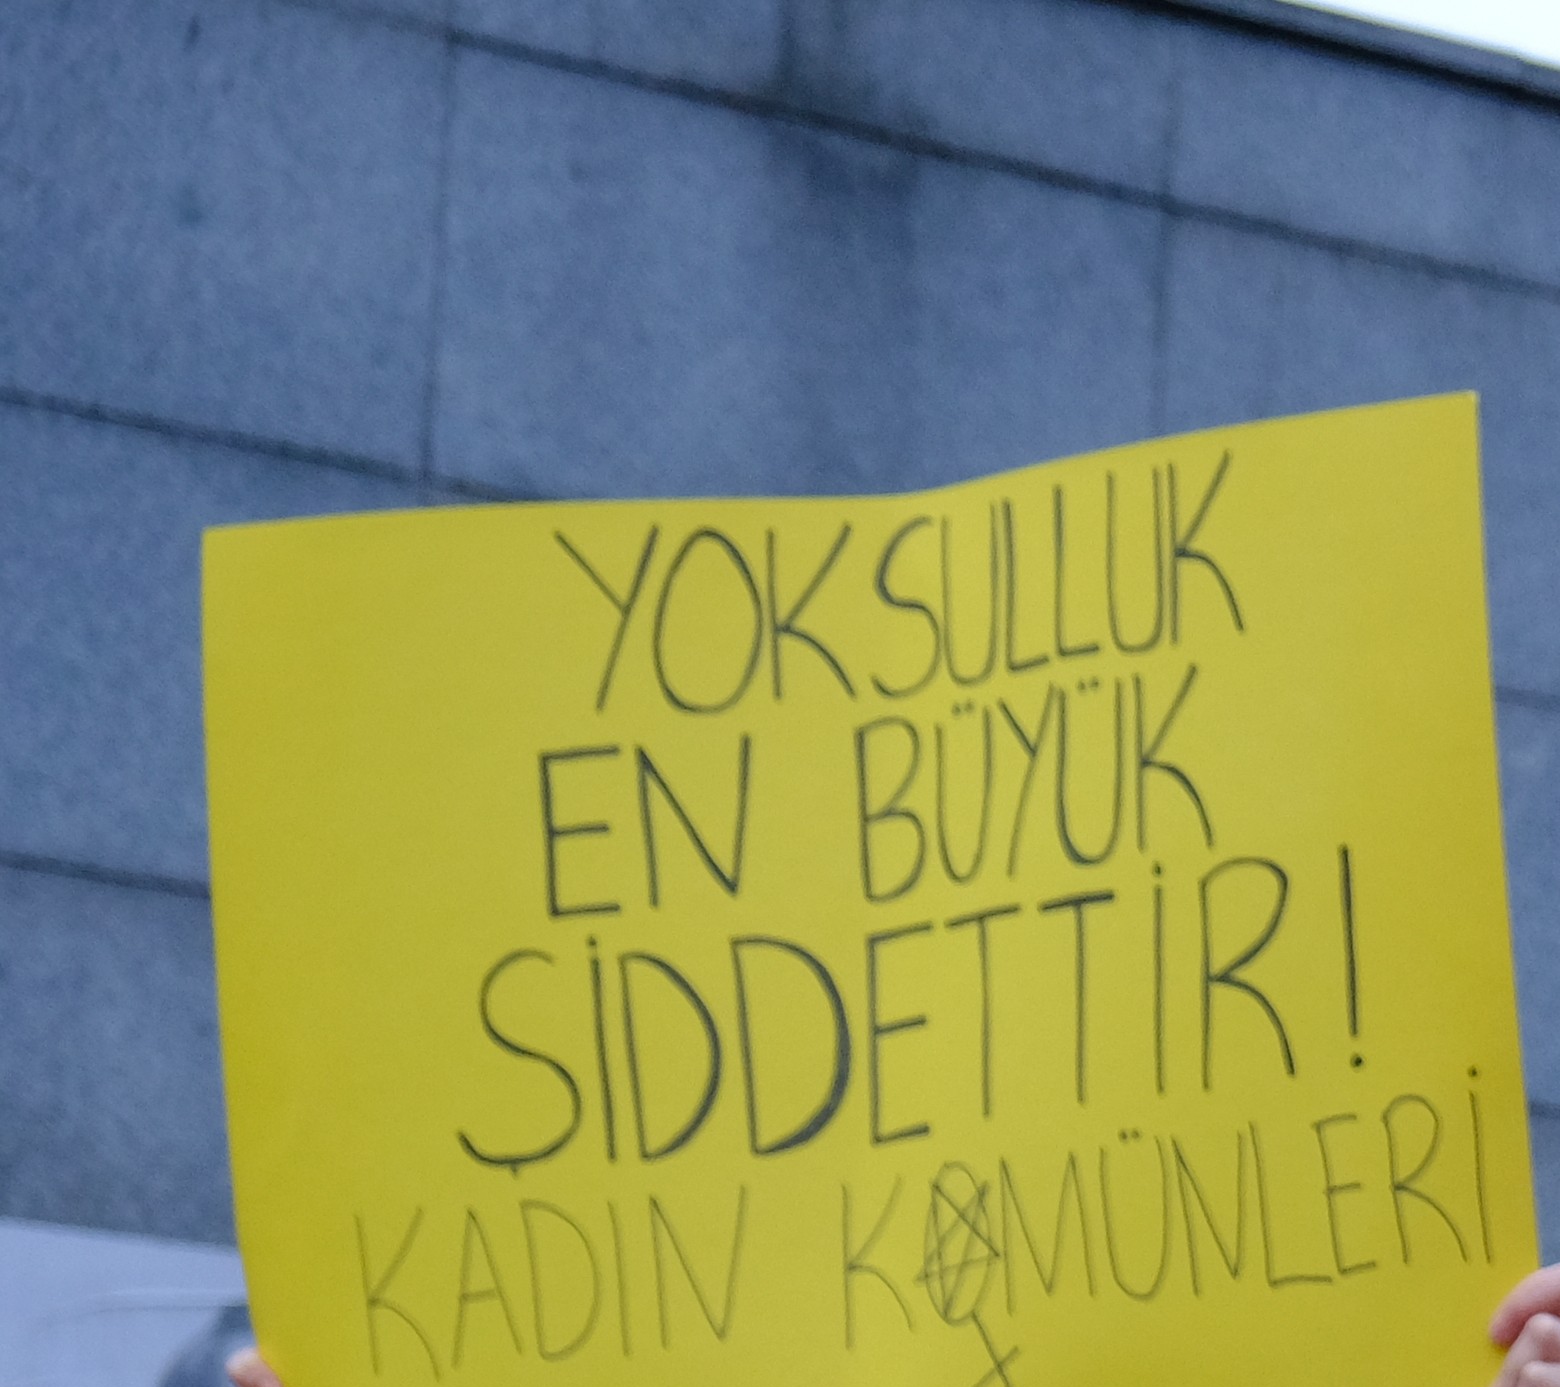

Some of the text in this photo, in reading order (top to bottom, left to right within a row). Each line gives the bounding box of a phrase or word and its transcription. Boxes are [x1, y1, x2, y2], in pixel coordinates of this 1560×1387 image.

[555, 450, 1246, 714] YOKSULLUK
[538, 663, 1216, 919] EN BÜYÜK
[354, 1185, 747, 1382] KADIN
